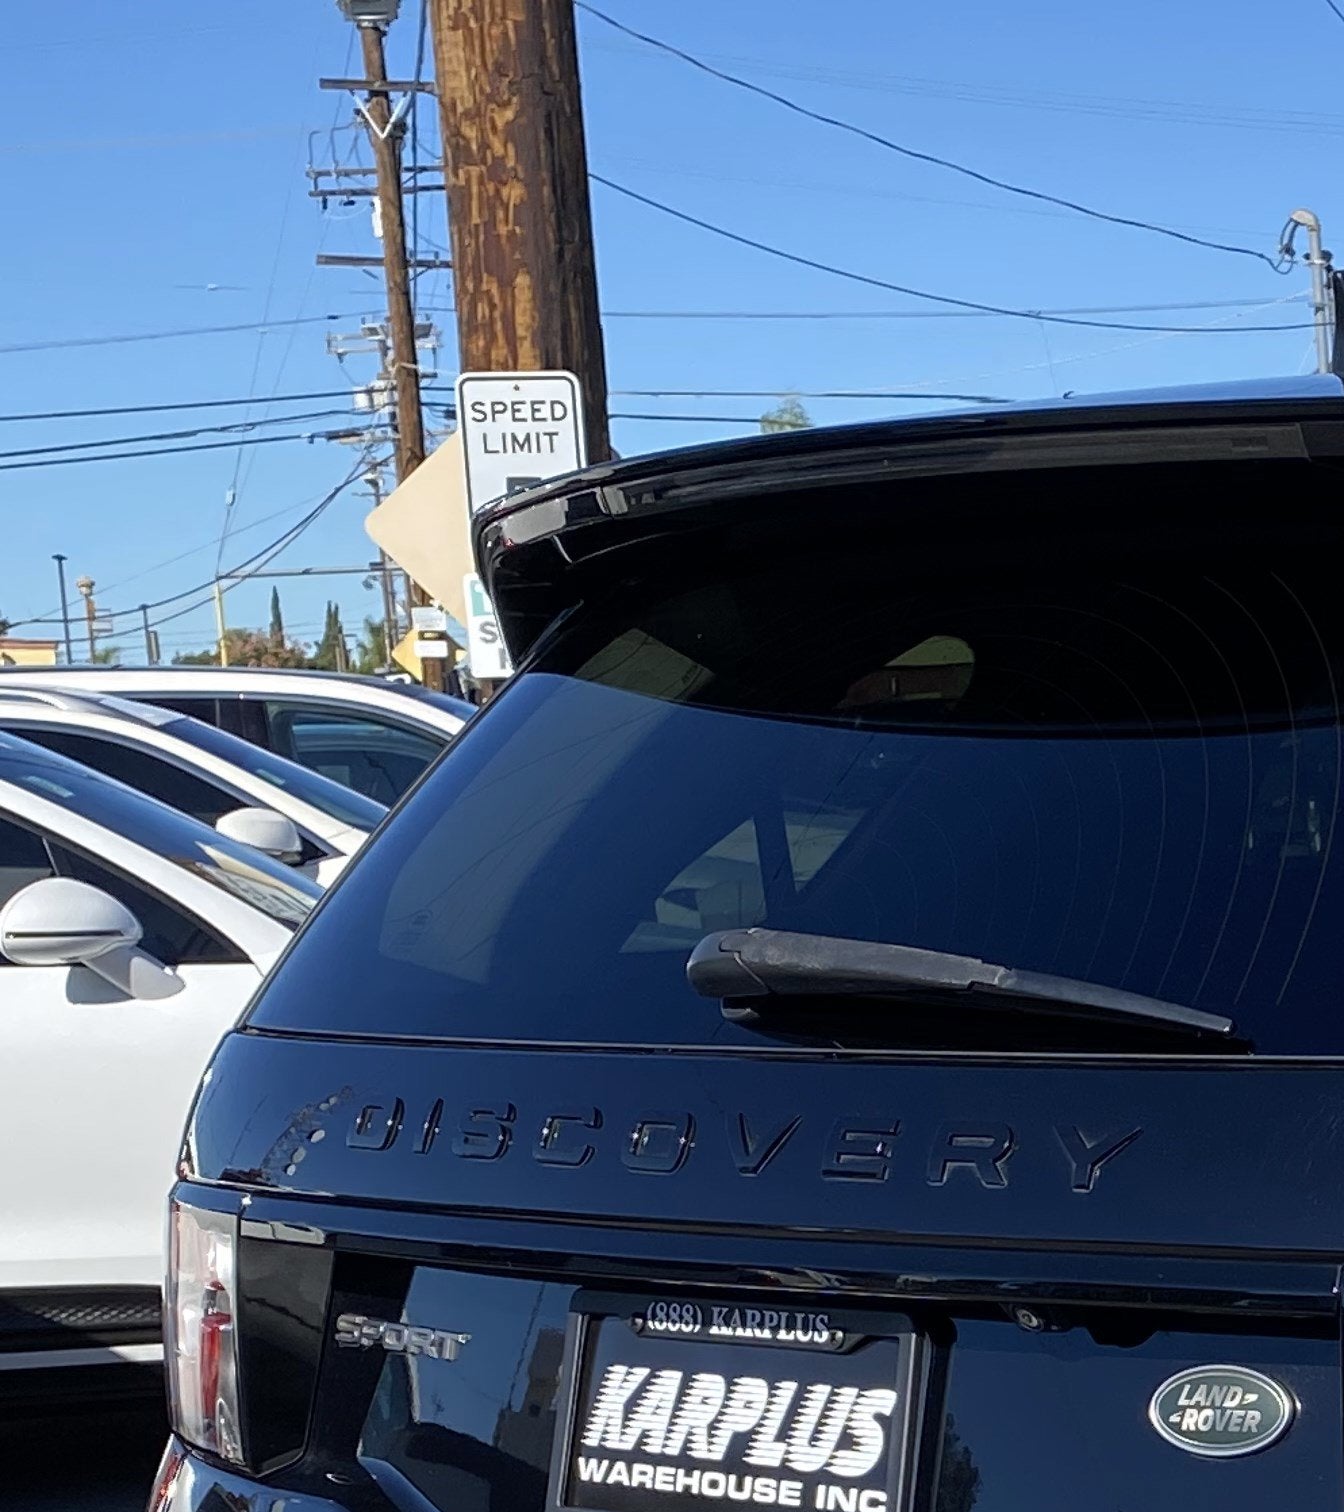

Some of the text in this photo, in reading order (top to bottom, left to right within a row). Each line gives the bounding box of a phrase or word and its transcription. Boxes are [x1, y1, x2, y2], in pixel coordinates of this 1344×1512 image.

[471, 400, 569, 423] SPEED
[482, 431, 560, 455] LIMIT
[345, 1097, 1145, 1194] DISCOVERY
[335, 1313, 469, 1361] SPORT
[646, 1302, 832, 1344] (888) KARPLUS
[580, 1364, 898, 1478] KARPLUS
[577, 1456, 804, 1506] WAREHOUSE
